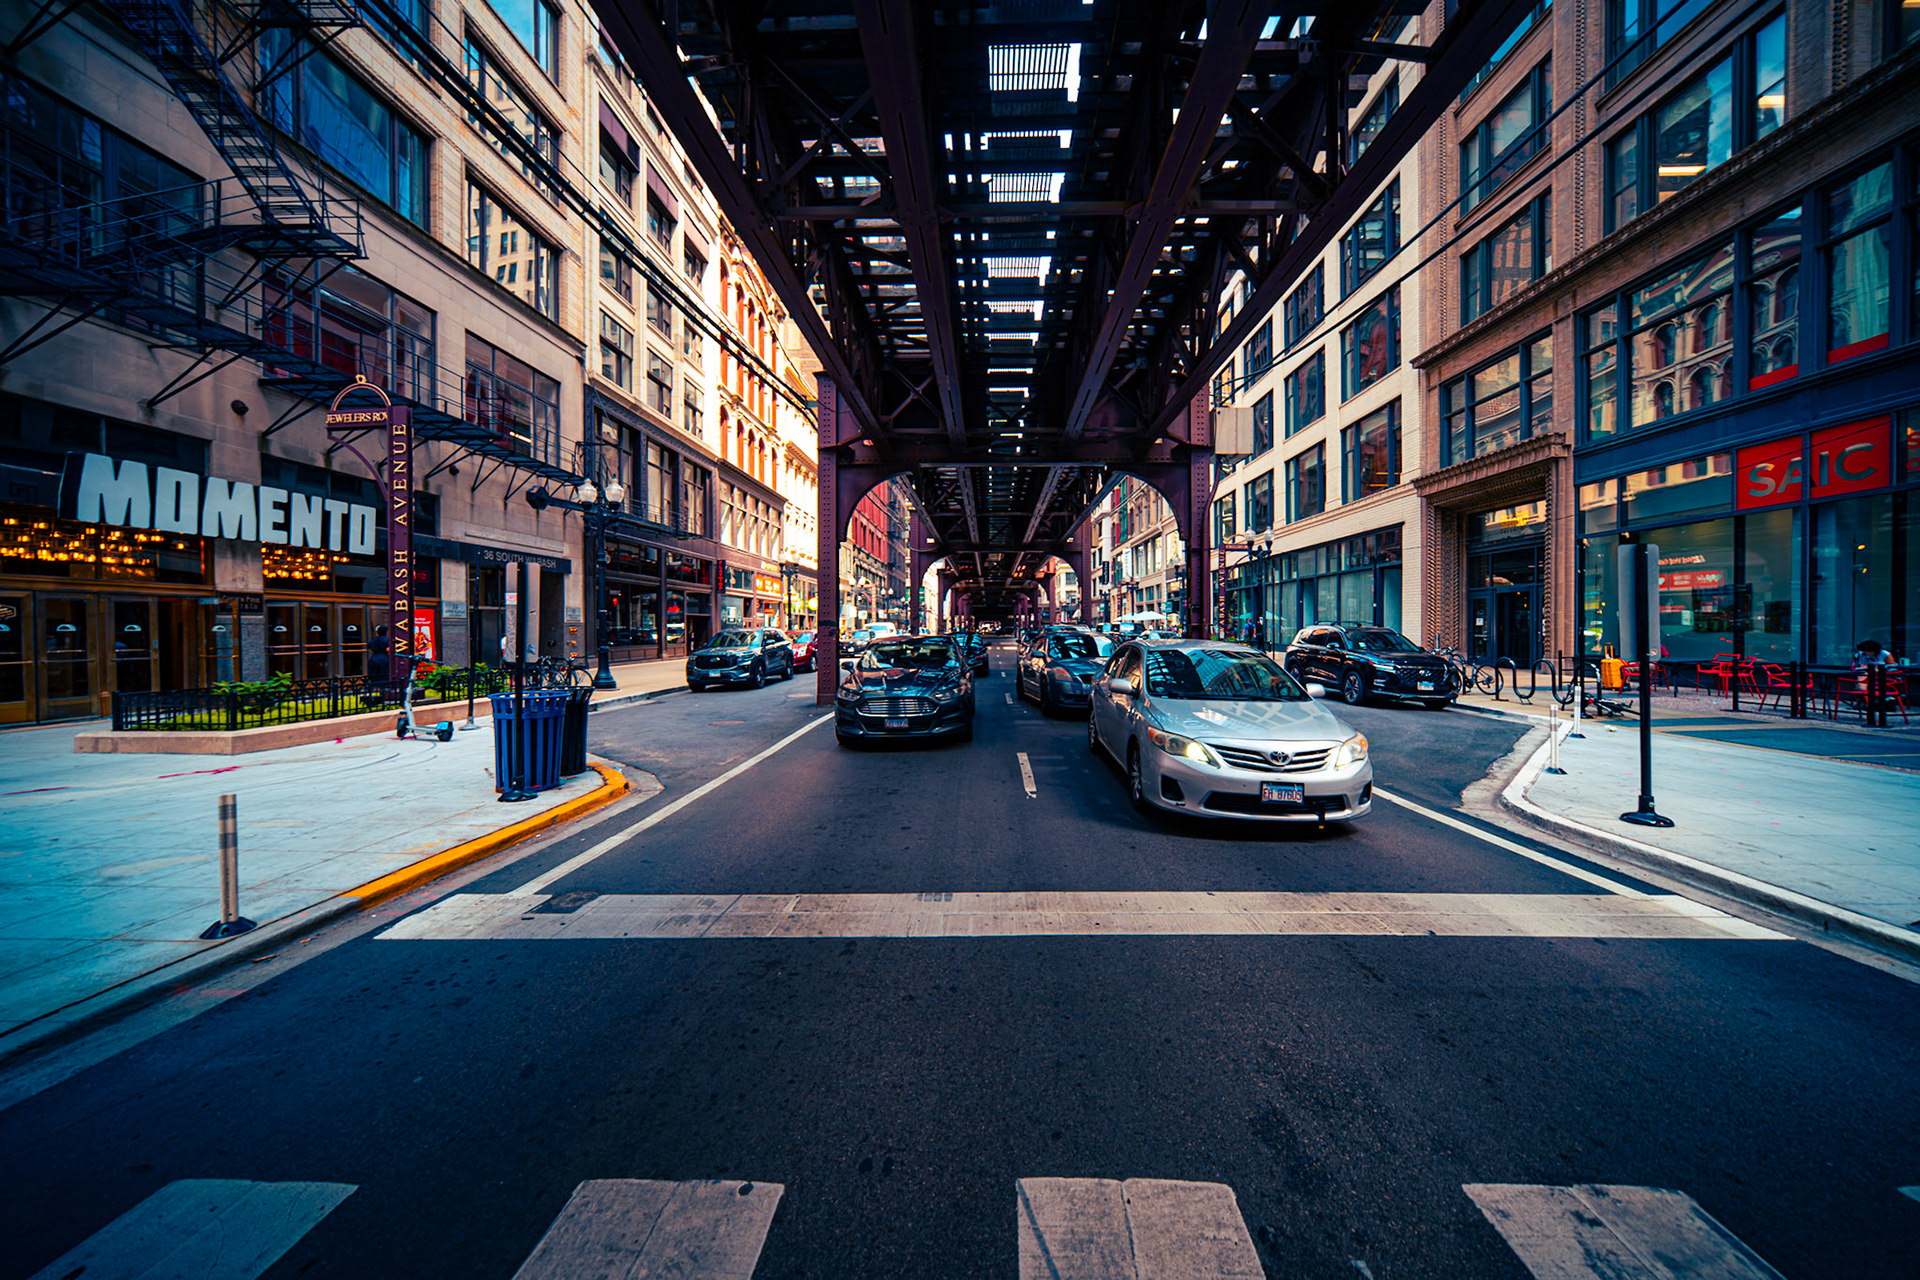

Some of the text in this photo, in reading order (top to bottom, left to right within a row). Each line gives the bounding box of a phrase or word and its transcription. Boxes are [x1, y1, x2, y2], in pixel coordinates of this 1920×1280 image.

[325, 412, 371, 424] JEWELERS
[1748, 442, 1876, 497] SAIC
[77, 452, 376, 556] MOMENTO
[392, 424, 409, 653] WABASH AVENUE
[483, 549, 557, 569] 36 SOUTH WABASH
